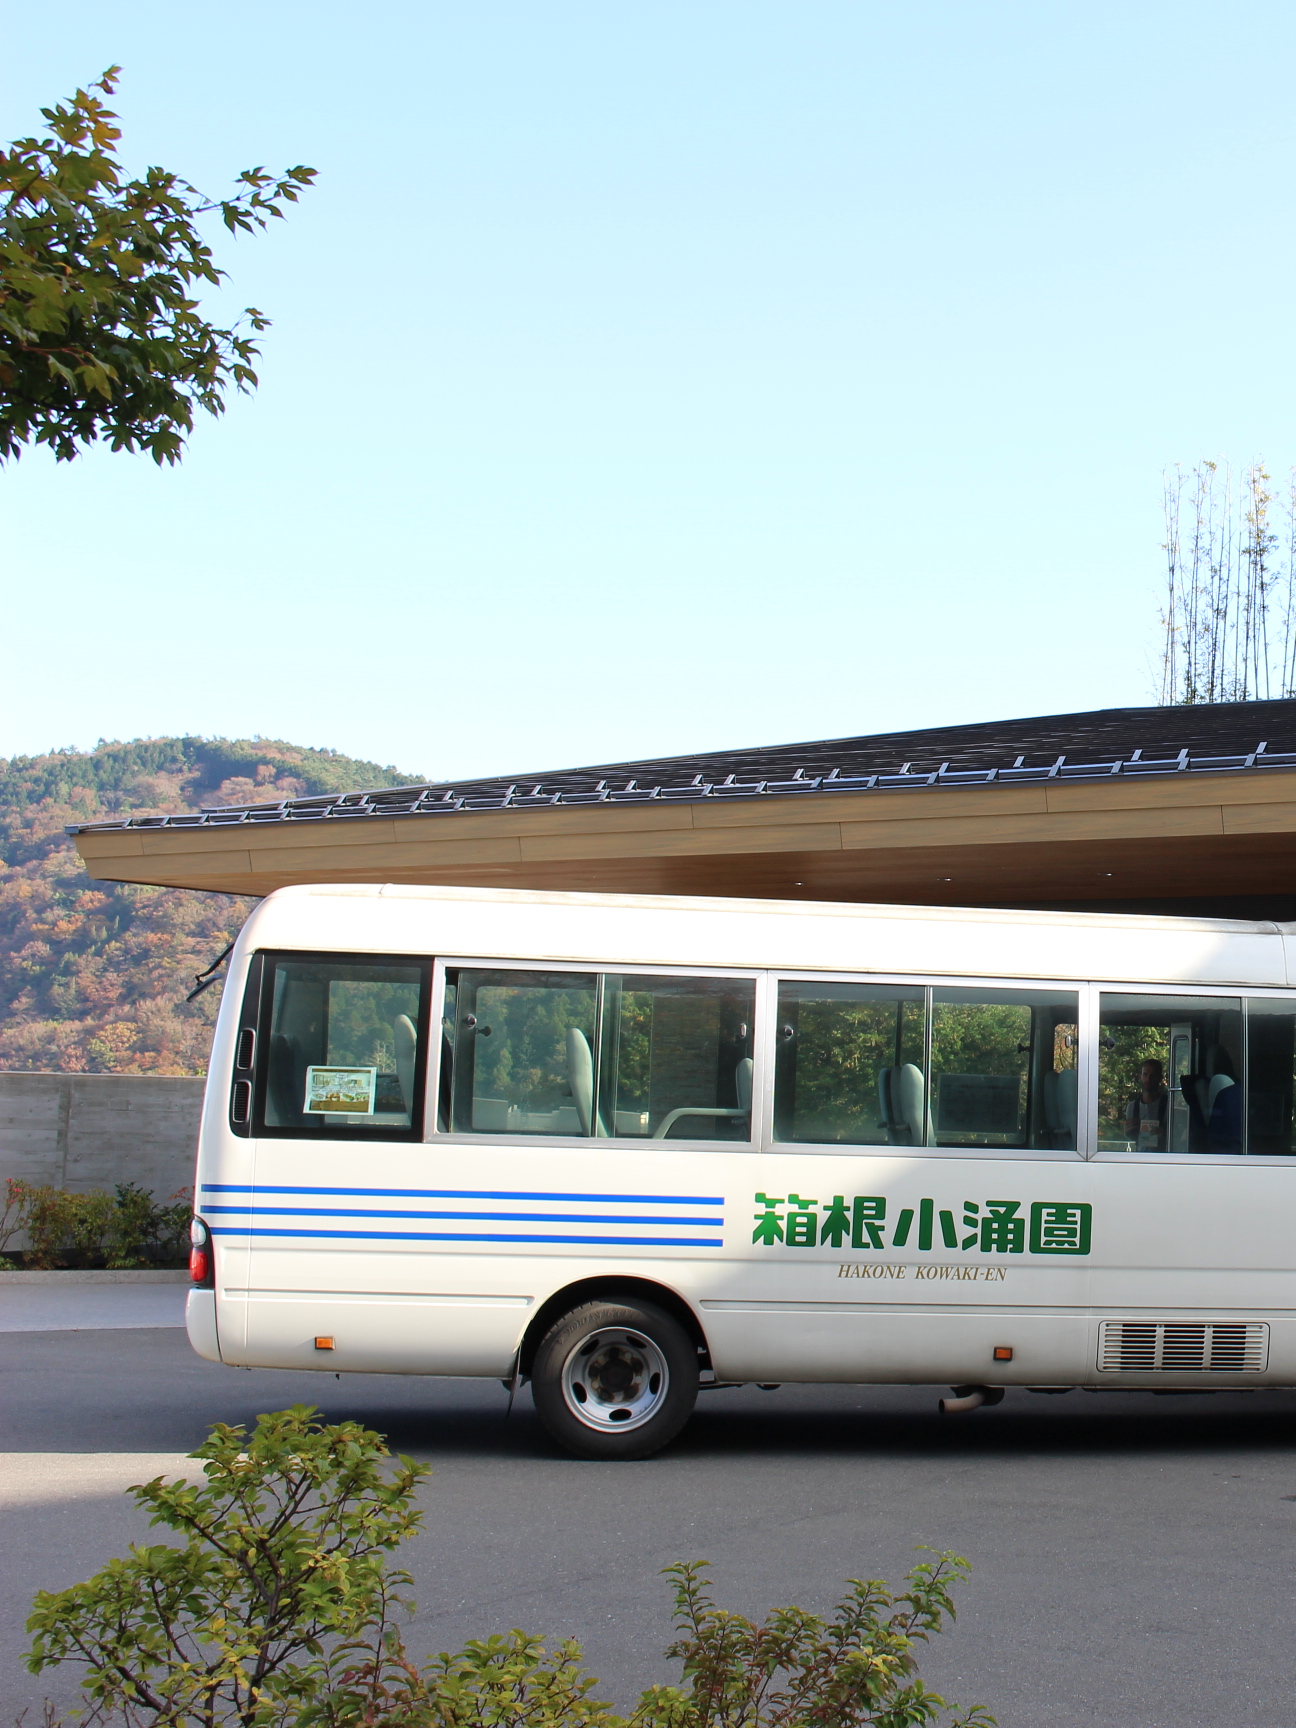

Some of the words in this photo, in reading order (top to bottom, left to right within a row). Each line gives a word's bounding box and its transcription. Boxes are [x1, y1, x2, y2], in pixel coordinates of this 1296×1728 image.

[752, 1192, 1093, 1256] 箱根小涌園
[837, 1264, 907, 1280] HAKONE
[914, 1265, 1008, 1282] KOWAKI-EN
